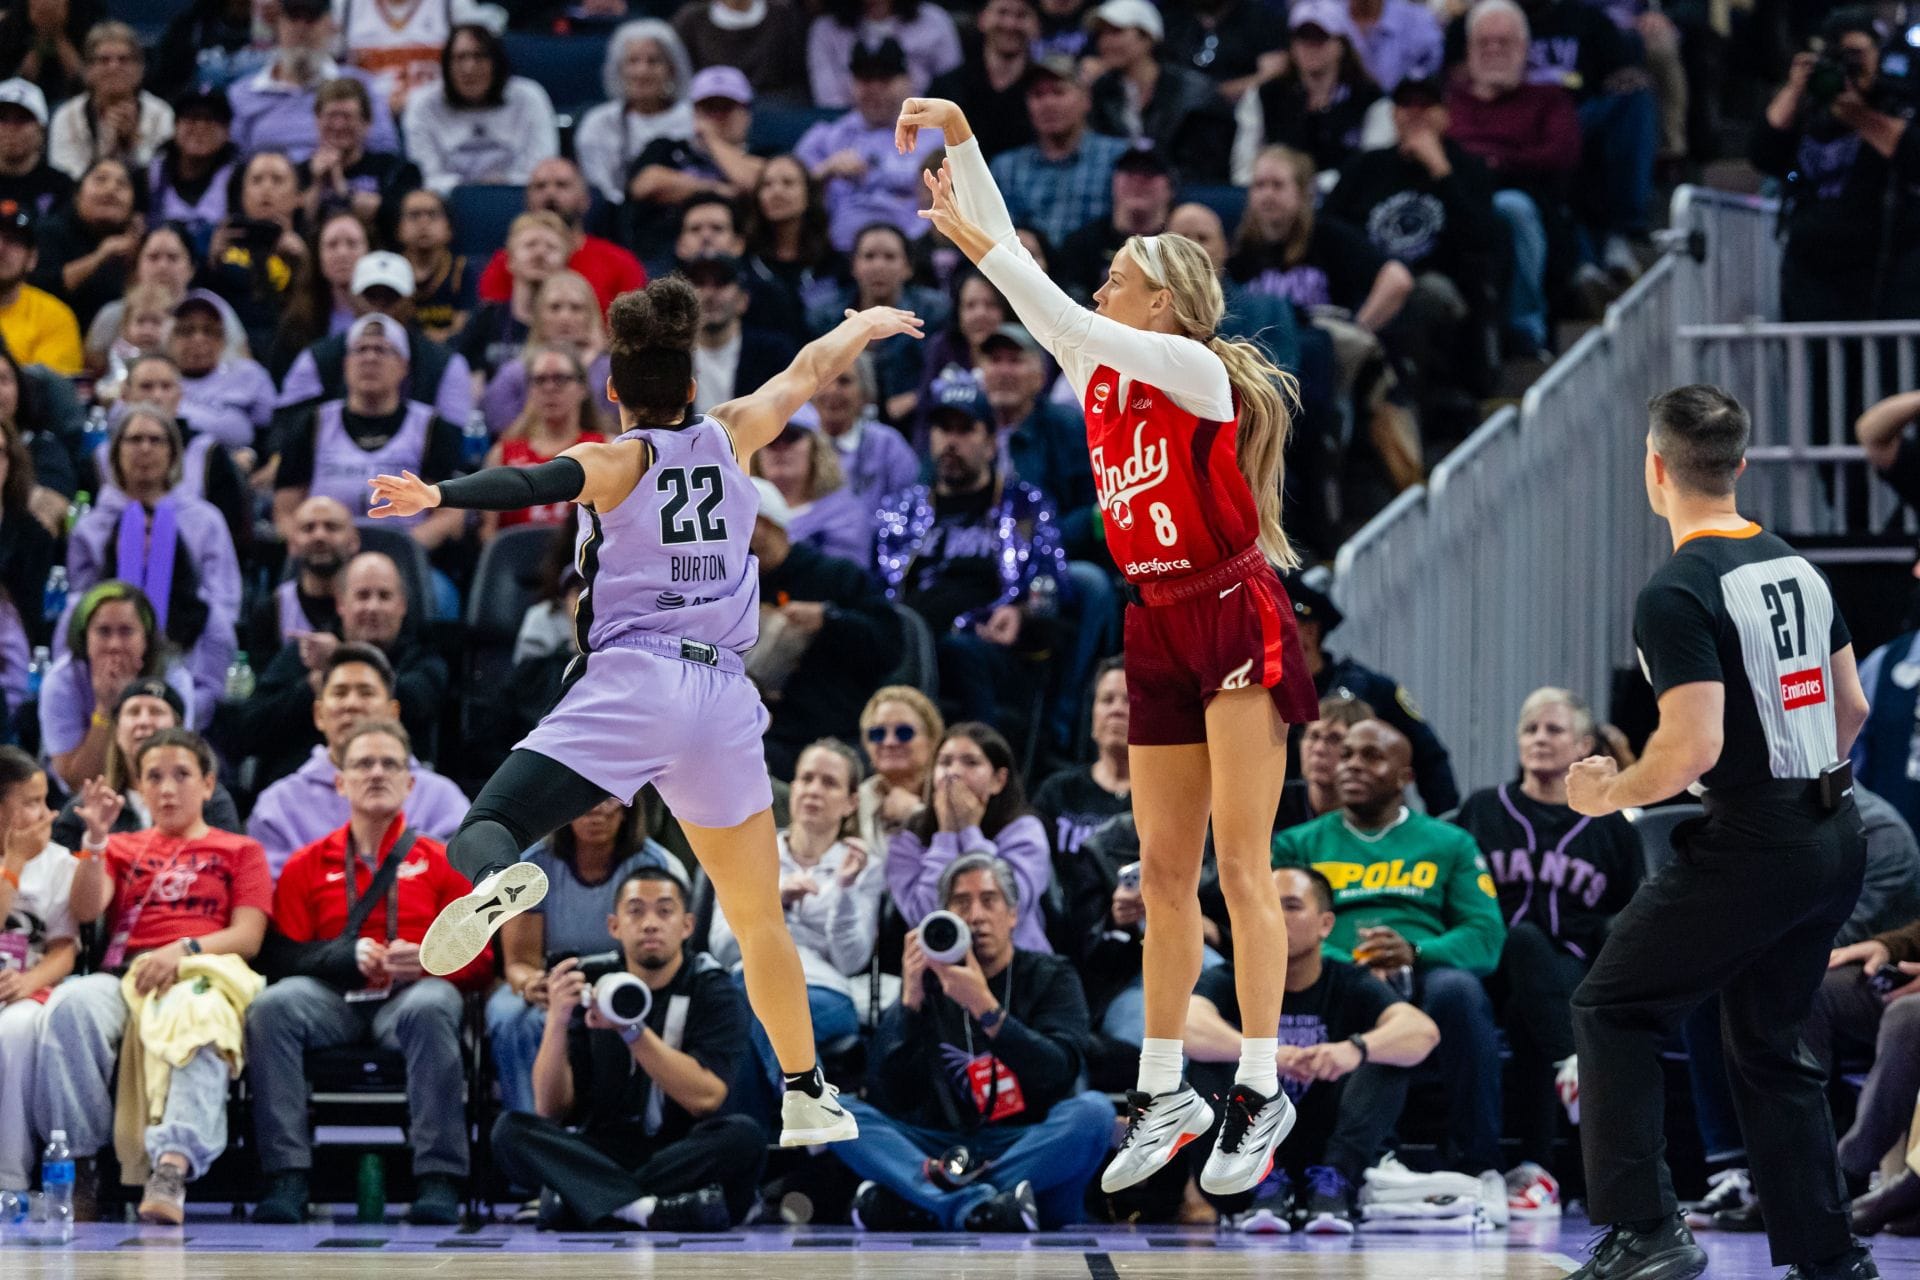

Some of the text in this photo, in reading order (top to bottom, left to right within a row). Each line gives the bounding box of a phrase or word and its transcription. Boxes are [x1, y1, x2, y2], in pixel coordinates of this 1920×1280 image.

[1091, 420, 1169, 512] Indy
[656, 464, 729, 545] 22
[1148, 501, 1178, 547] 8
[671, 554, 727, 582] BURTON
[1760, 577, 1807, 661] 27
[1781, 679, 1821, 701] Emirates
[1314, 858, 1438, 890] POLO
[1490, 847, 1608, 908] IANTS
